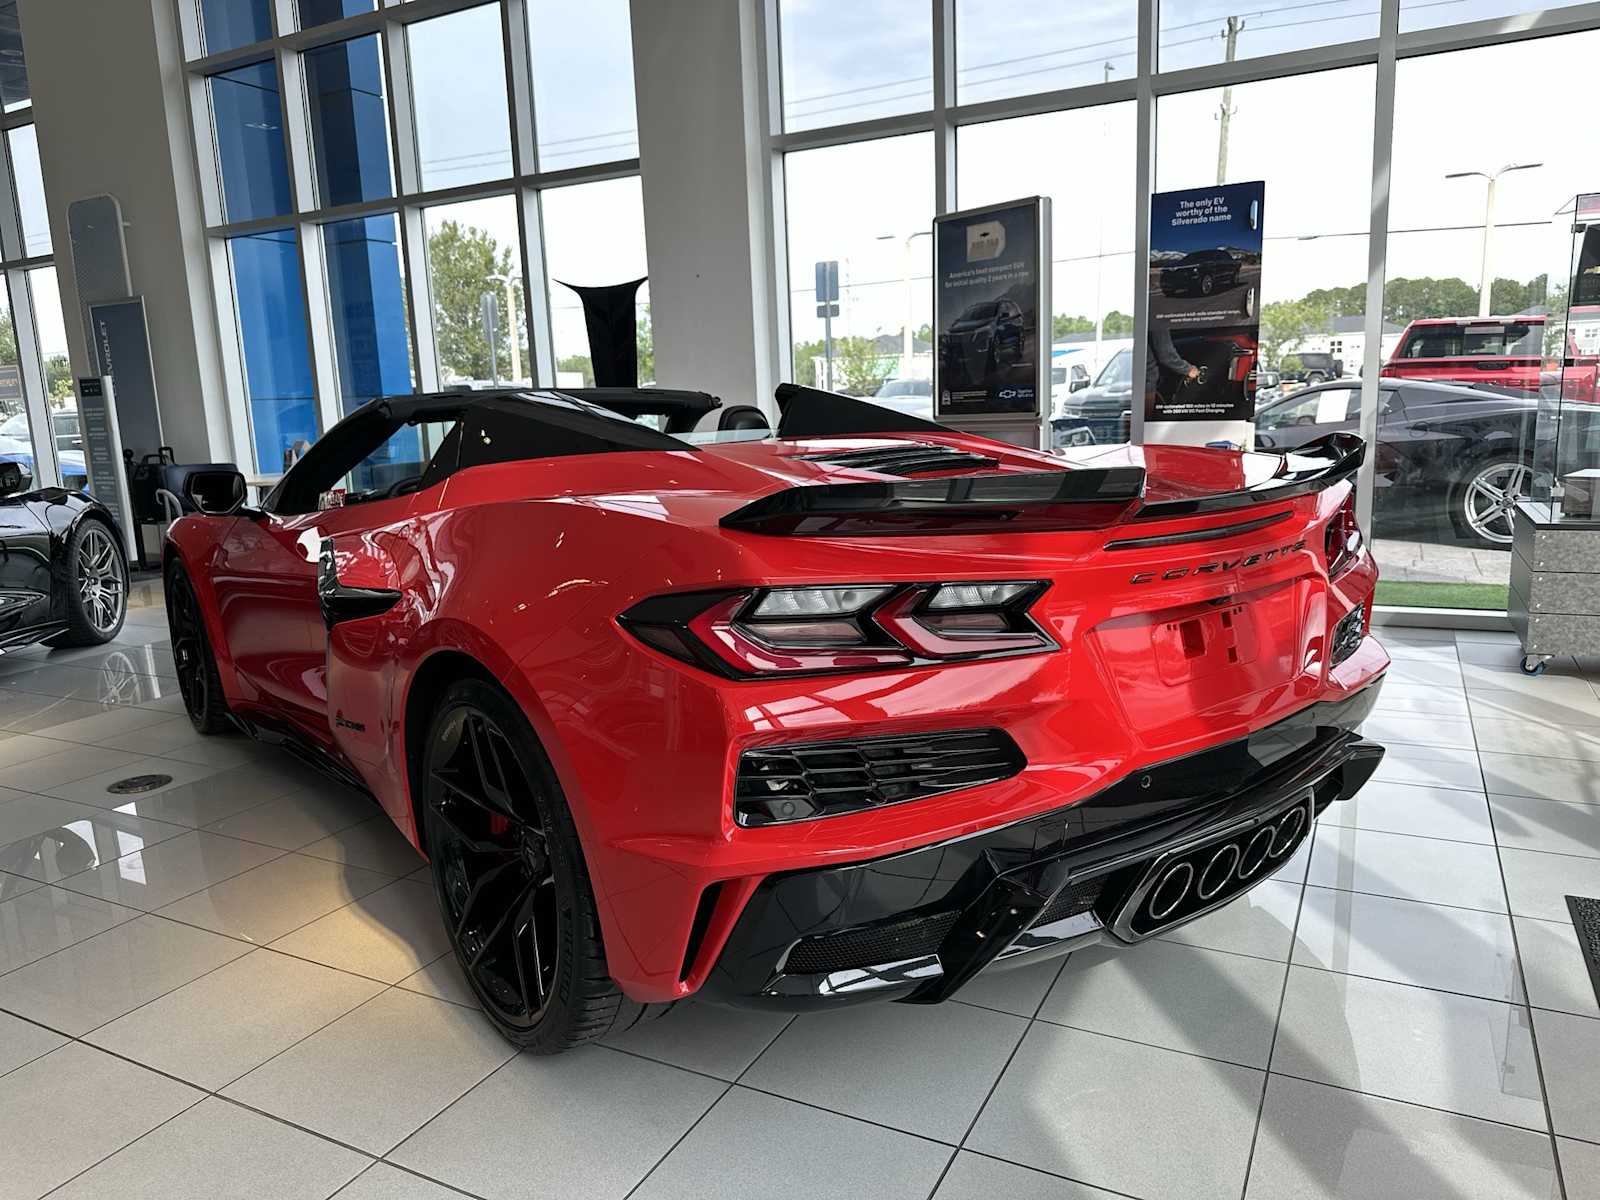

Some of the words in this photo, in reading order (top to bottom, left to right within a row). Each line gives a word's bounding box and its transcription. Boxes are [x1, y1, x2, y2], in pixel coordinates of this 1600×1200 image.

[1180, 200, 1195, 209] The
[1195, 198, 1213, 207] only
[1213, 197, 1225, 205] EV
[1175, 208, 1203, 218] worthy
[1204, 207, 1213, 215] of
[1214, 205, 1228, 213] the
[1171, 215, 1208, 226] Silverado
[1208, 214, 1232, 222] name
[1130, 539, 1307, 585] CORVETTE
